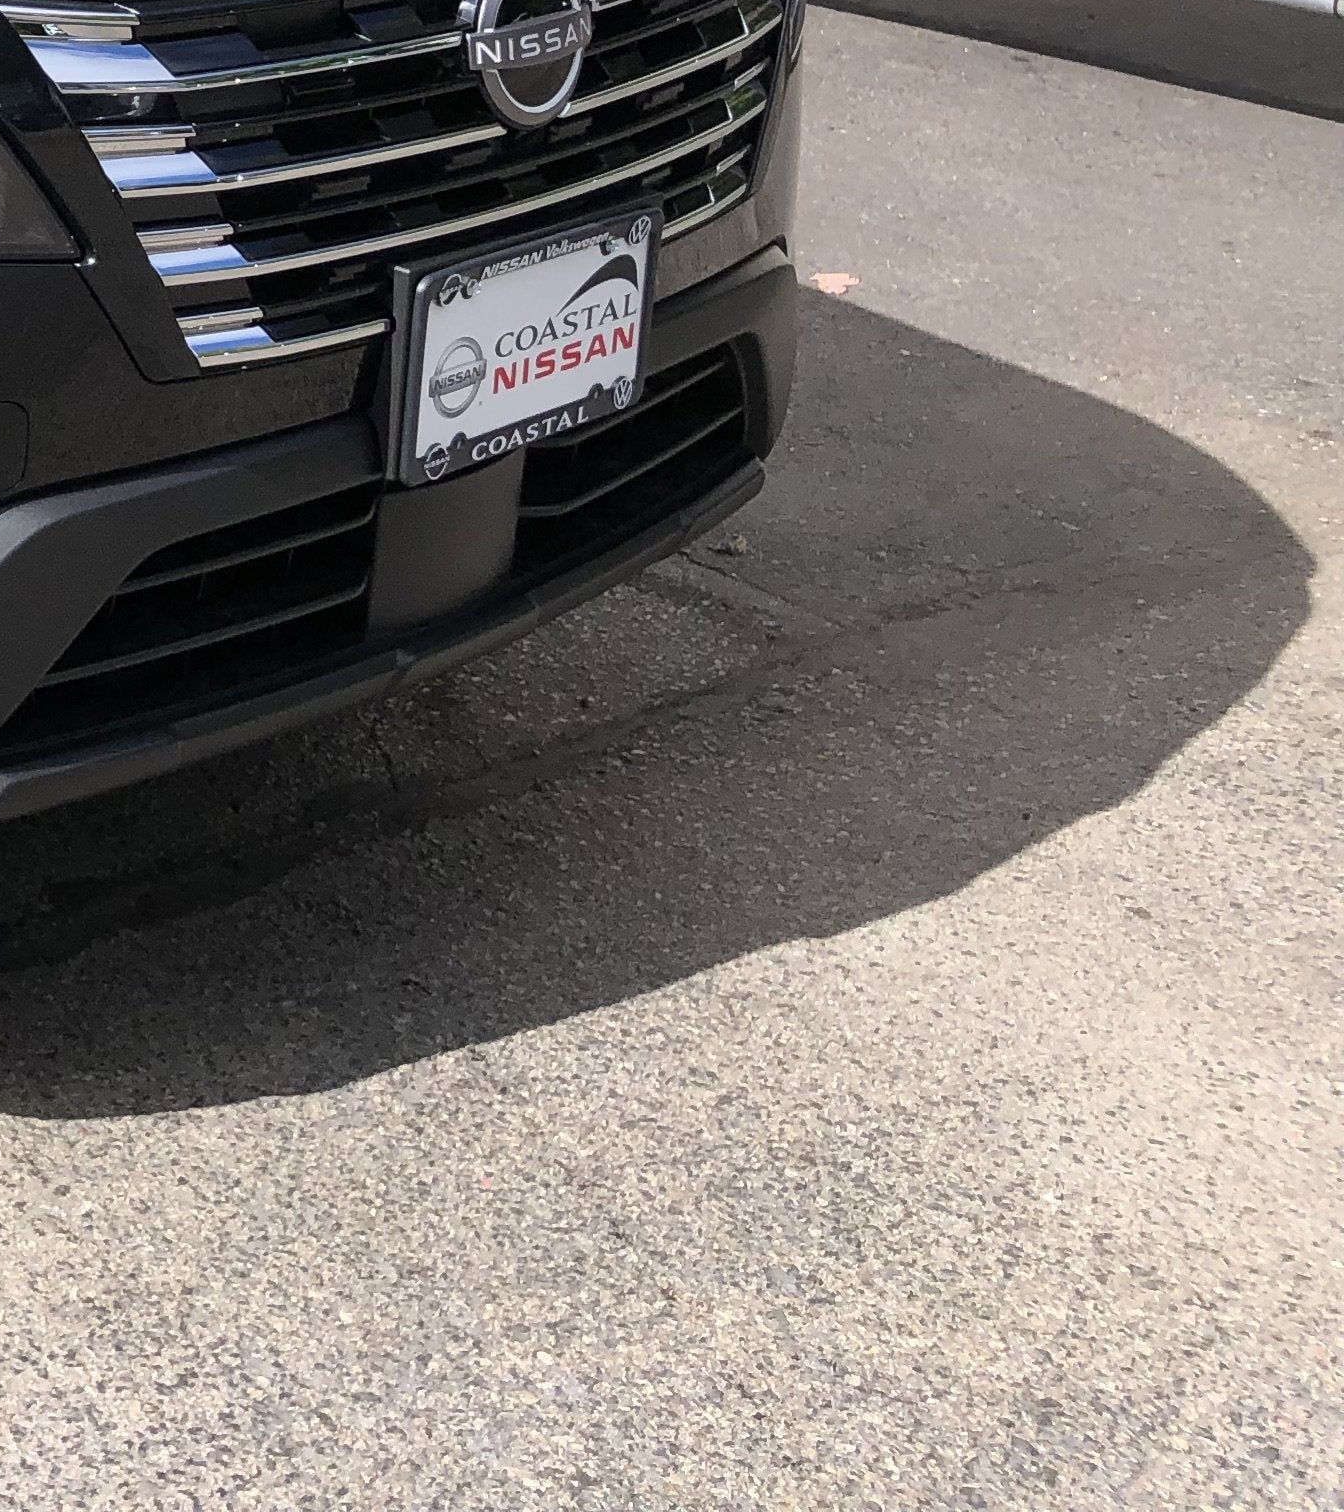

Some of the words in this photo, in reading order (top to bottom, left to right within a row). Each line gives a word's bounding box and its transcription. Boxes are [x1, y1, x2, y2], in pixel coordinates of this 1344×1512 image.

[475, 17, 592, 65] NISSAN
[480, 250, 544, 280] NISSAN
[494, 293, 637, 358] COASTAL
[434, 363, 482, 390] NISSAN
[492, 322, 635, 394] NISSAN
[471, 406, 589, 462] COASTAL
